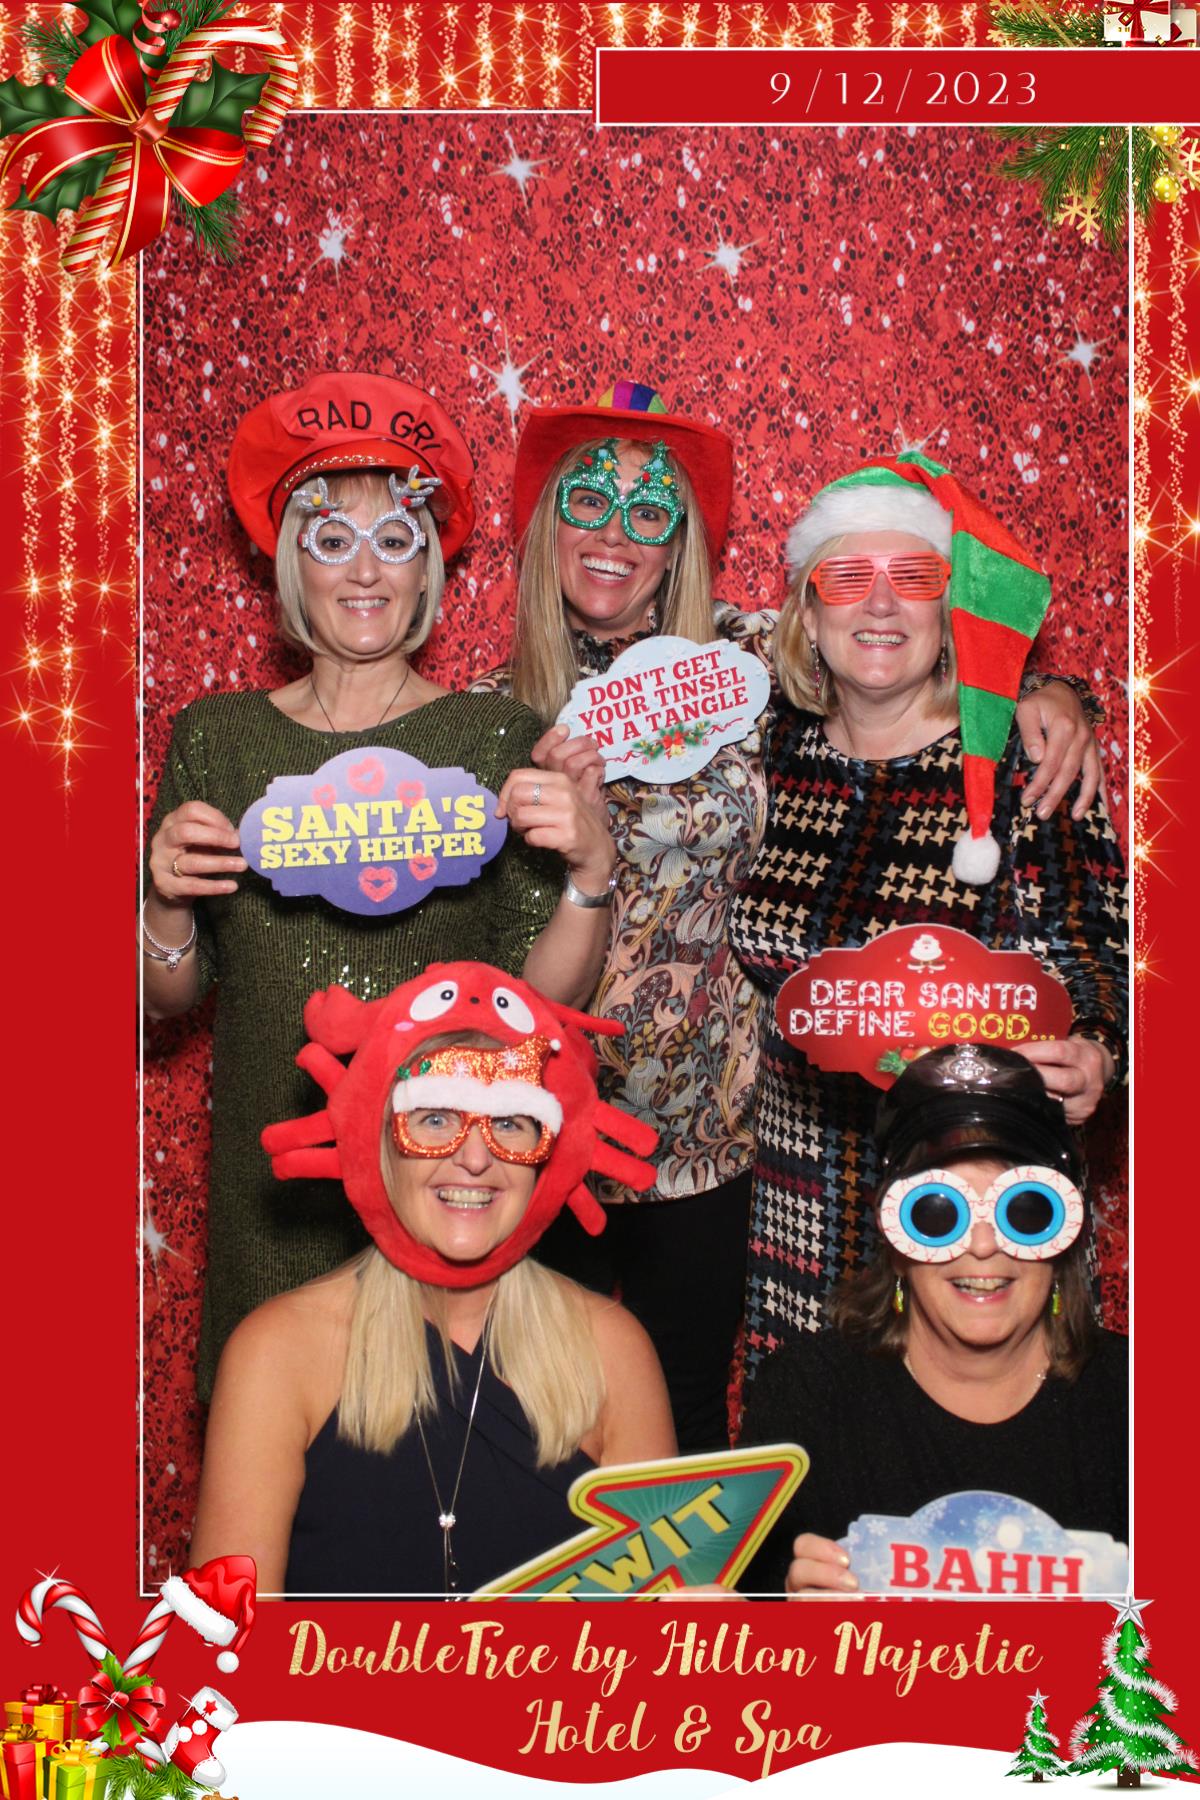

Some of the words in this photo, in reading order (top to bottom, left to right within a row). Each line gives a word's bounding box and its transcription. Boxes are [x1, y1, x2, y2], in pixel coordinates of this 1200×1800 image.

[578, 695, 650, 730] YOUR
[654, 667, 746, 708] TINSEL
[588, 667, 665, 706] DON'T
[672, 650, 721, 680] GET
[585, 728, 614, 749] N
[622, 720, 641, 741] A
[645, 687, 748, 732] TANGLE
[261, 795, 486, 842] SANTA'S
[260, 840, 351, 869] SEXY
[358, 832, 486, 863] HELPER
[811, 979, 905, 1007] DEAR
[918, 982, 1037, 1010] SANTA
[790, 1009, 915, 1037] DEFINE
[928, 1012, 1055, 1040] GOOD...
[889, 1543, 1084, 1599] BAHH
